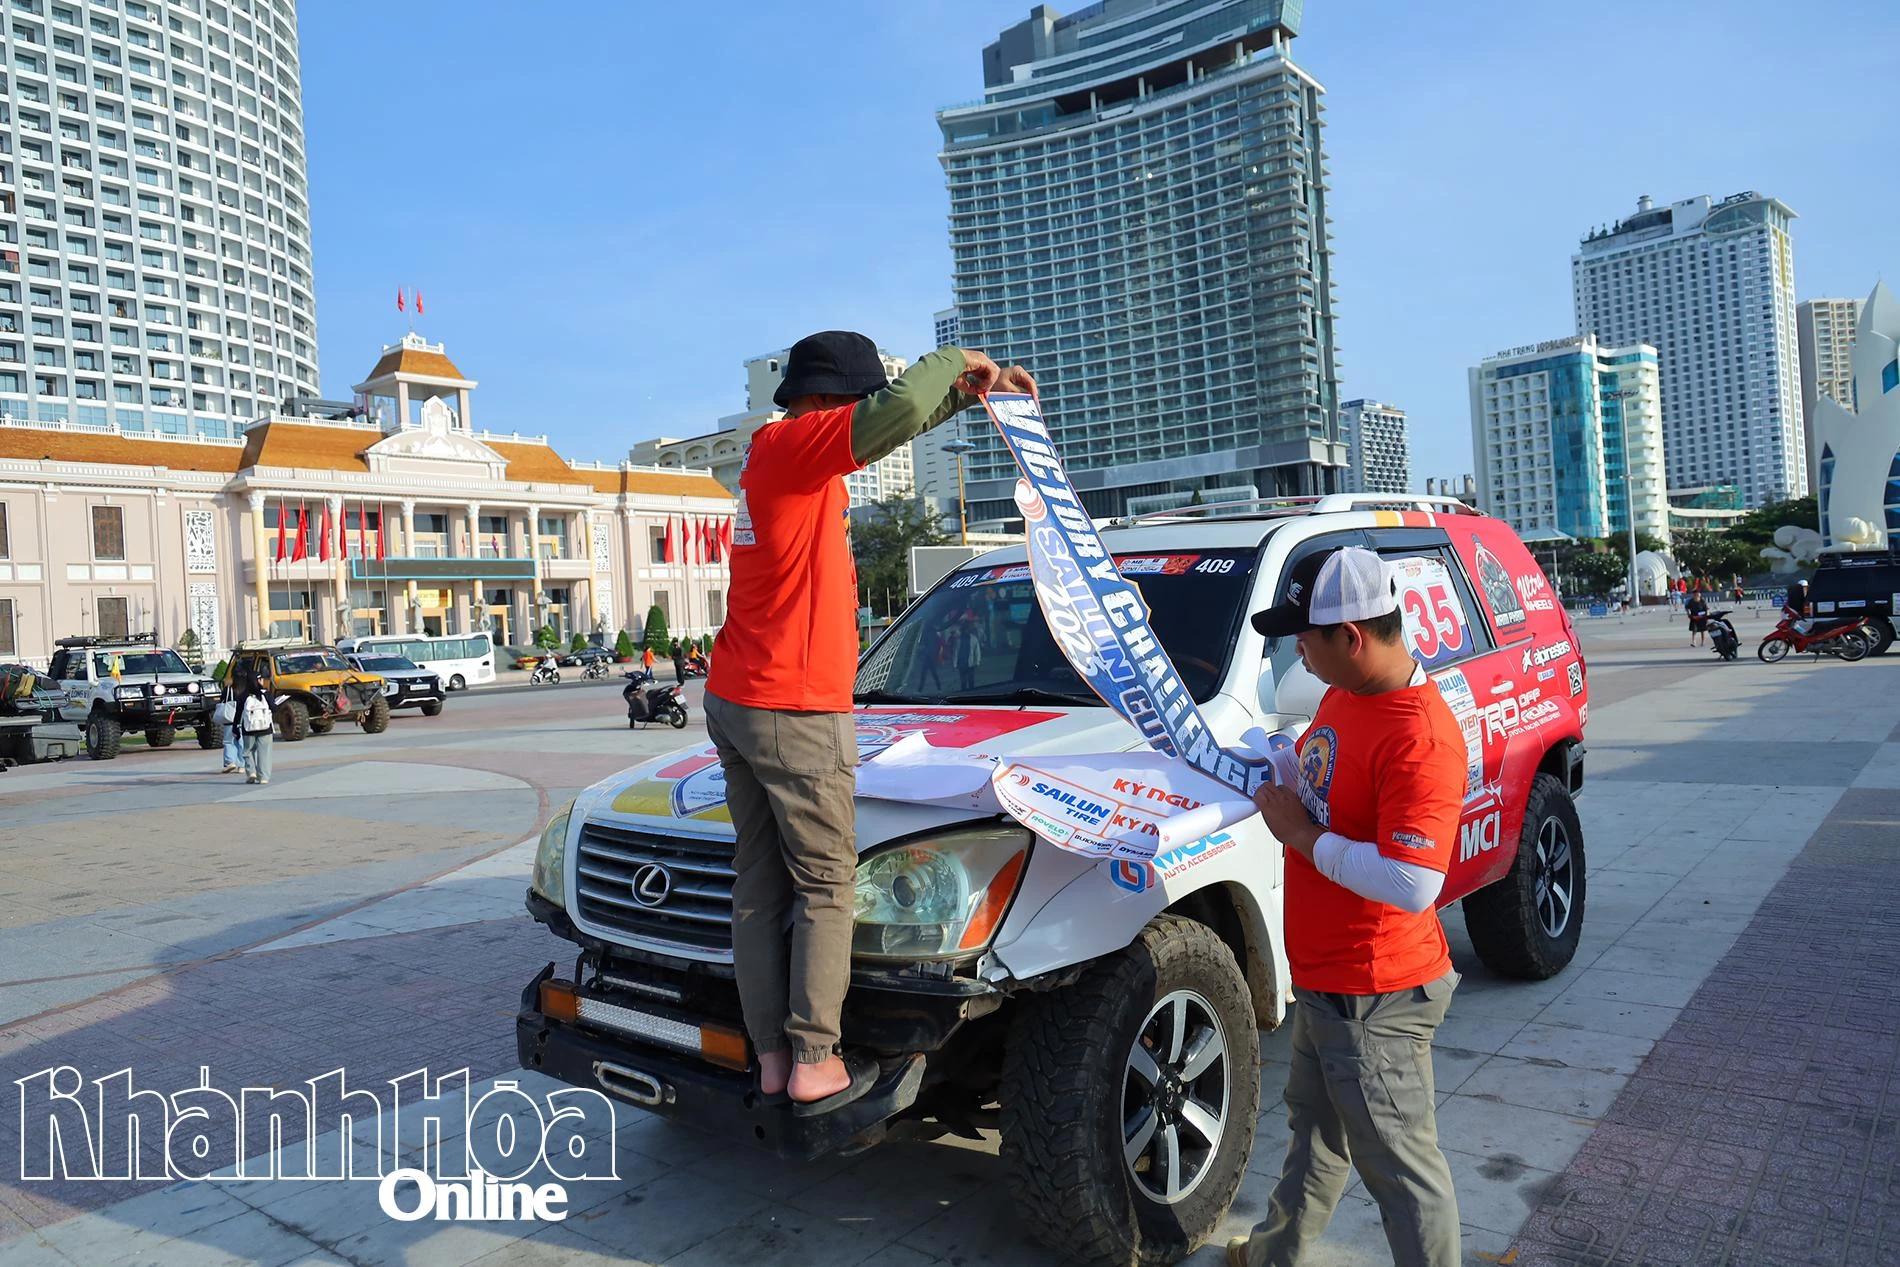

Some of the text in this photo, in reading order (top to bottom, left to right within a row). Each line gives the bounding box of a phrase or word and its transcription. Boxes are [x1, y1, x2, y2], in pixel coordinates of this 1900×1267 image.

[949, 575, 979, 589] 409
[1195, 559, 1235, 574] 409
[989, 400, 1269, 797] VICTORY CHALLENGE
[1402, 583, 1463, 659] 35
[1035, 527, 1179, 759] SAILUN CUP
[1533, 640, 1571, 666] alpinestars
[1437, 673, 1466, 694] AILUN
[1518, 687, 1541, 709] OFF
[1477, 697, 1559, 746] TRD ROAD
[1032, 783, 1110, 819] SAILUN
[1066, 808, 1100, 826] TIRE
[1460, 810, 1500, 864] MCI
[1163, 840, 1237, 880] AUTO ACCESSORIES
